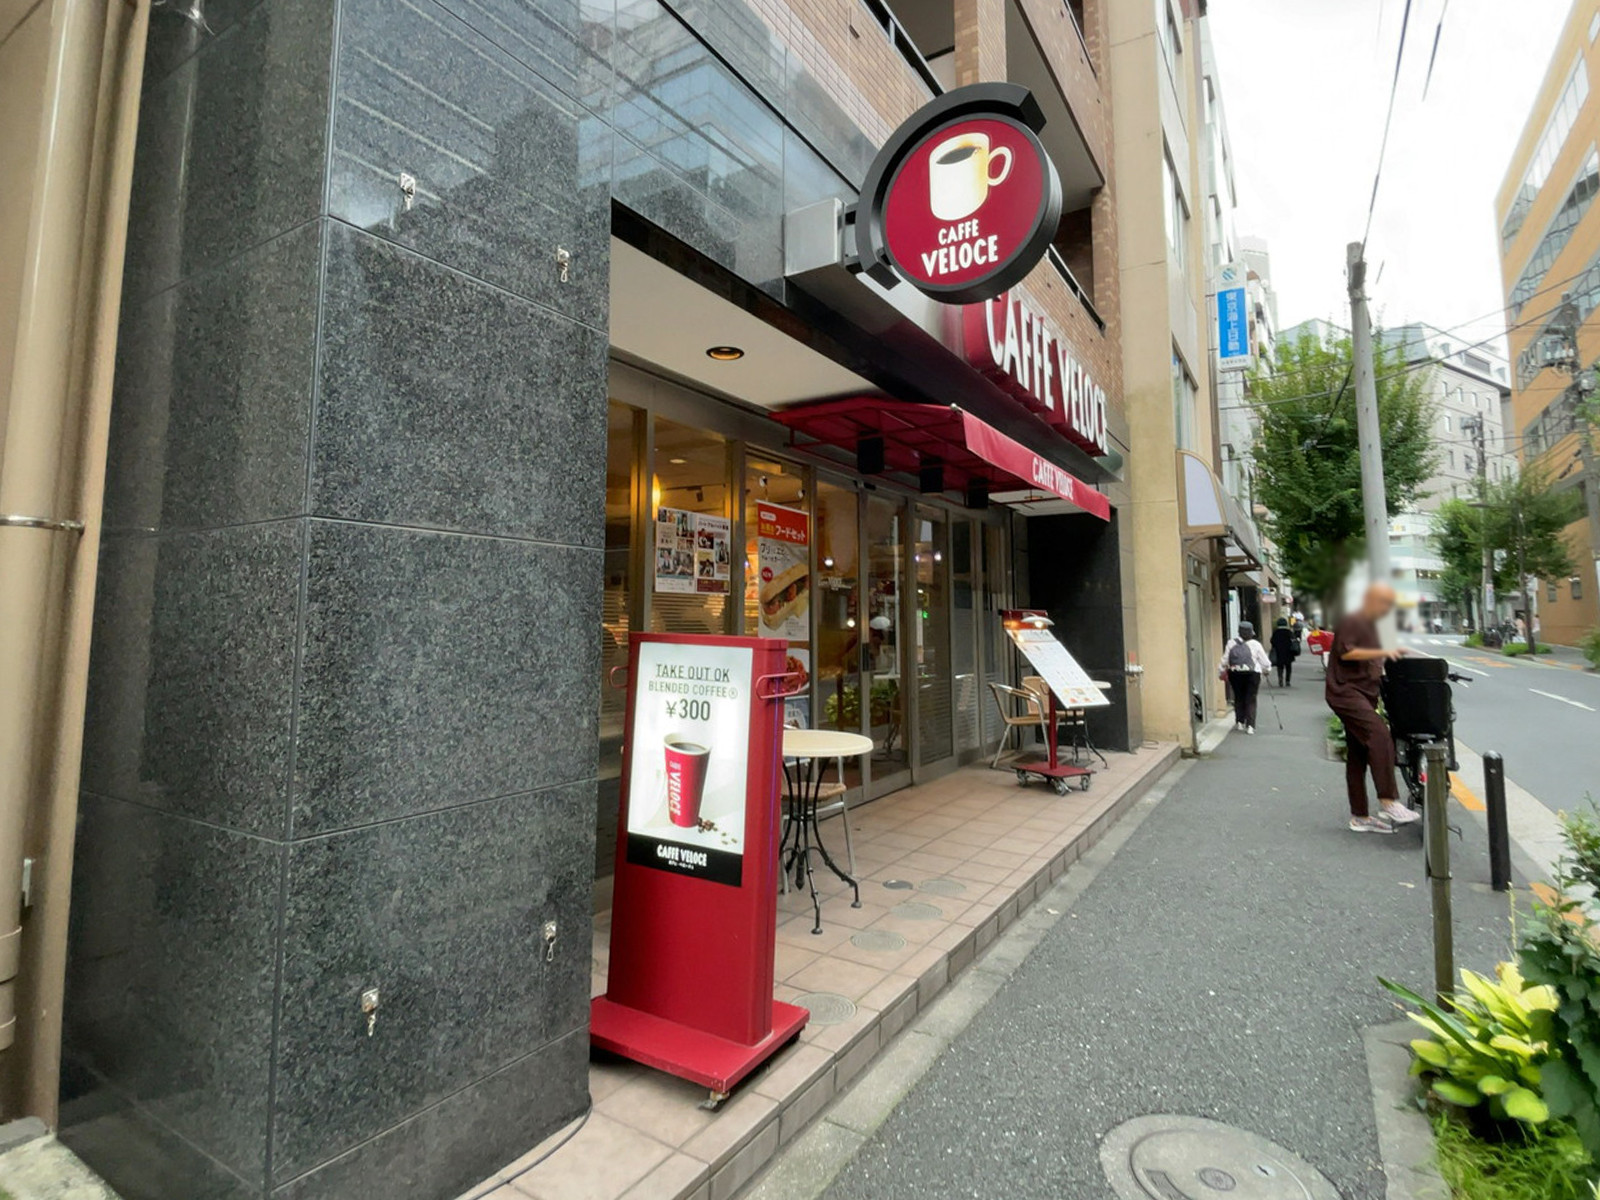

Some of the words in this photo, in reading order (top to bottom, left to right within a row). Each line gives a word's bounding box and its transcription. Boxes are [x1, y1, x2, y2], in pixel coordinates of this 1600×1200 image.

[921, 234, 998, 278] VELOCE
[656, 663, 685, 679] TAKE
[687, 666, 711, 681] OUT
[714, 668, 731, 682] OK
[648, 680, 690, 695] BLENDED
[692, 684, 727, 698] COFFEE
[665, 698, 711, 721] ¥300
[680, 849, 708, 867] VELOCE
